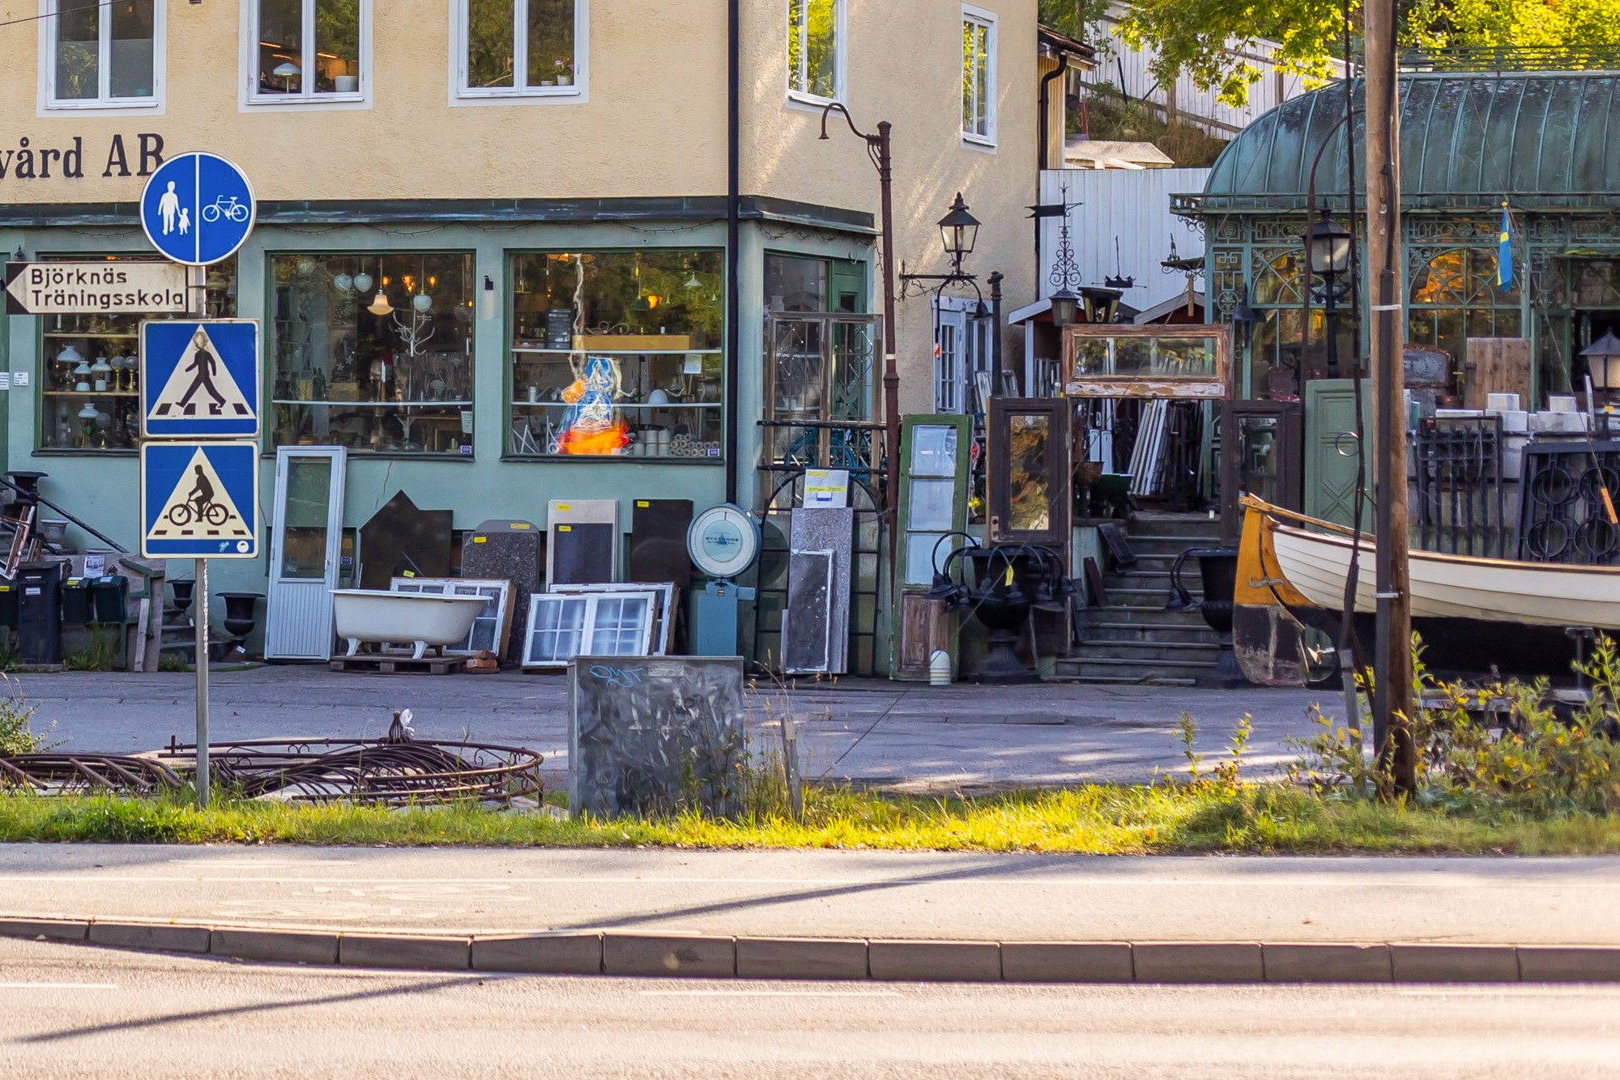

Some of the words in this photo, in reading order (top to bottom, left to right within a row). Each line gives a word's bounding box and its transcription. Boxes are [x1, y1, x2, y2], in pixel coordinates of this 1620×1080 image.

[102, 133, 165, 177] AB
[31, 267, 127, 289] Björknäs
[31, 289, 184, 309] Träningsskola
